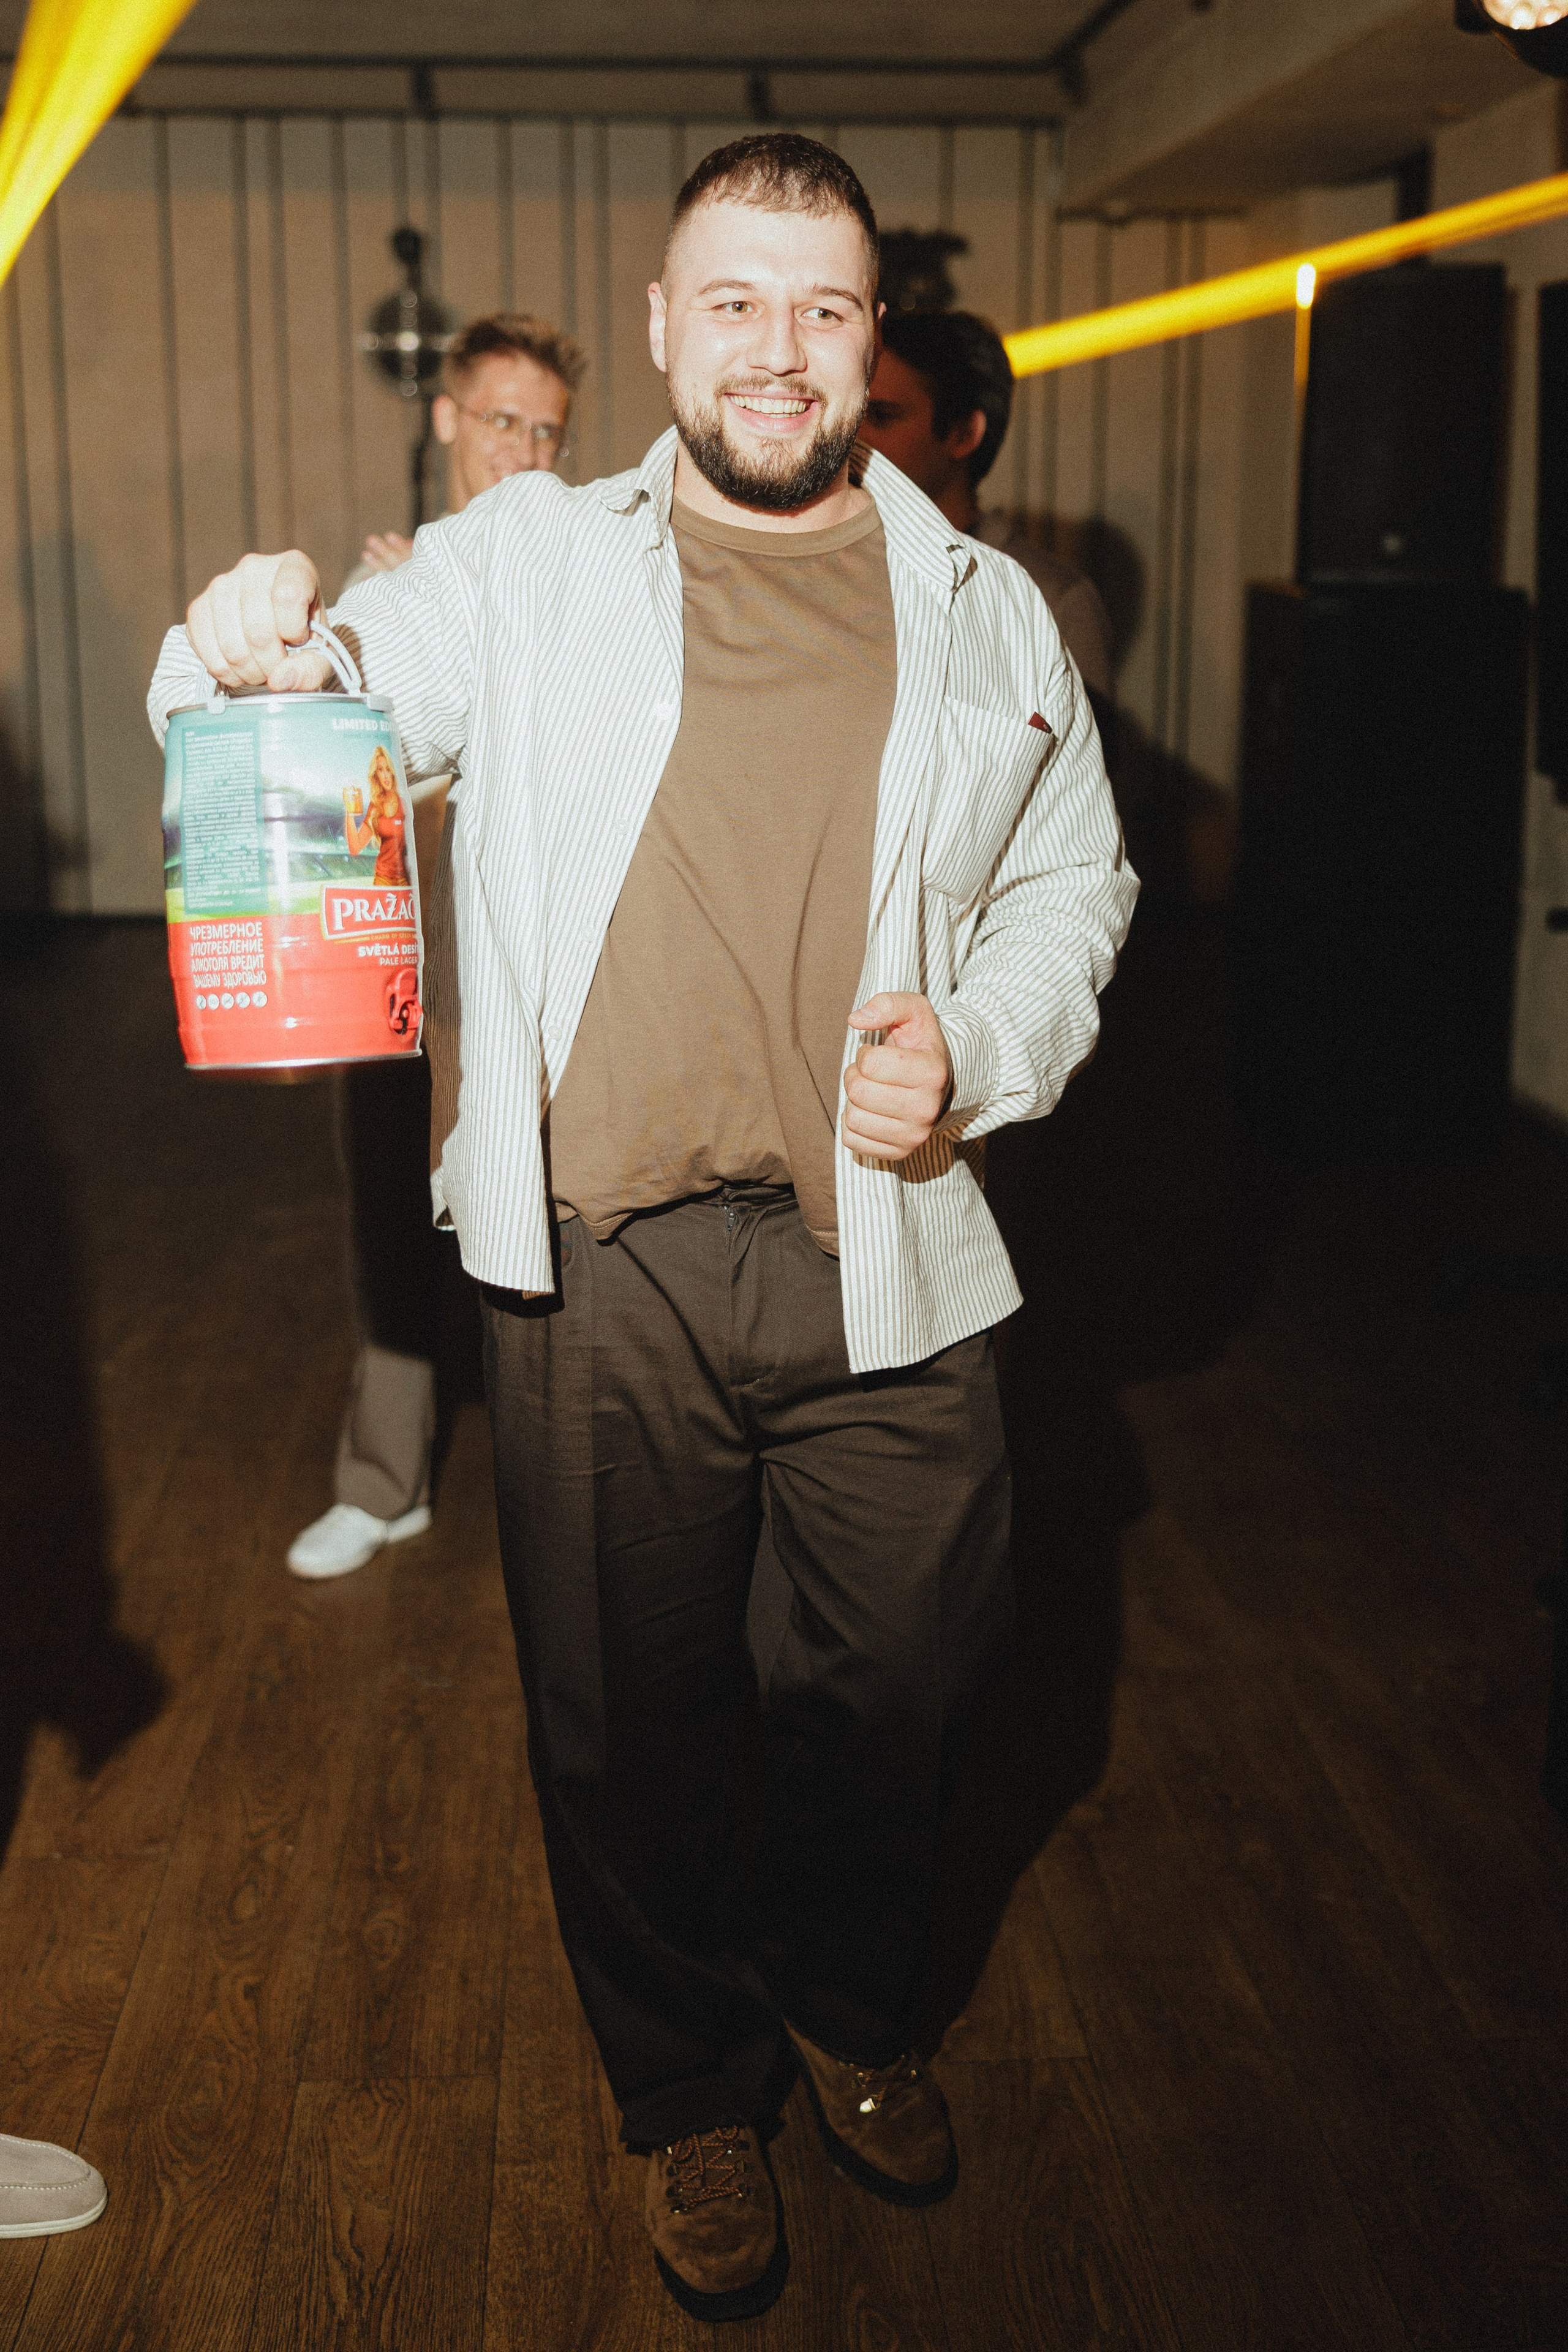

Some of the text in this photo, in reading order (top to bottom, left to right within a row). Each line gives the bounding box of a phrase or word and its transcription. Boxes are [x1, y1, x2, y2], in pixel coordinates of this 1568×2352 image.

[332, 718, 378, 731] LIMITED
[190, 922, 263, 940] ЧРЕЗМЕРНОЕ
[190, 938, 263, 956] УПОТРЕБЛЕНИЕ
[358, 943, 399, 957] SVĚTLÁ
[192, 954, 265, 972] АЛКОГОЛЯ ВРЕДИТ
[401, 956, 418, 965] LAGER
[193, 970, 267, 989] ВАШЕМУ ЗДОРОВЬЮ
